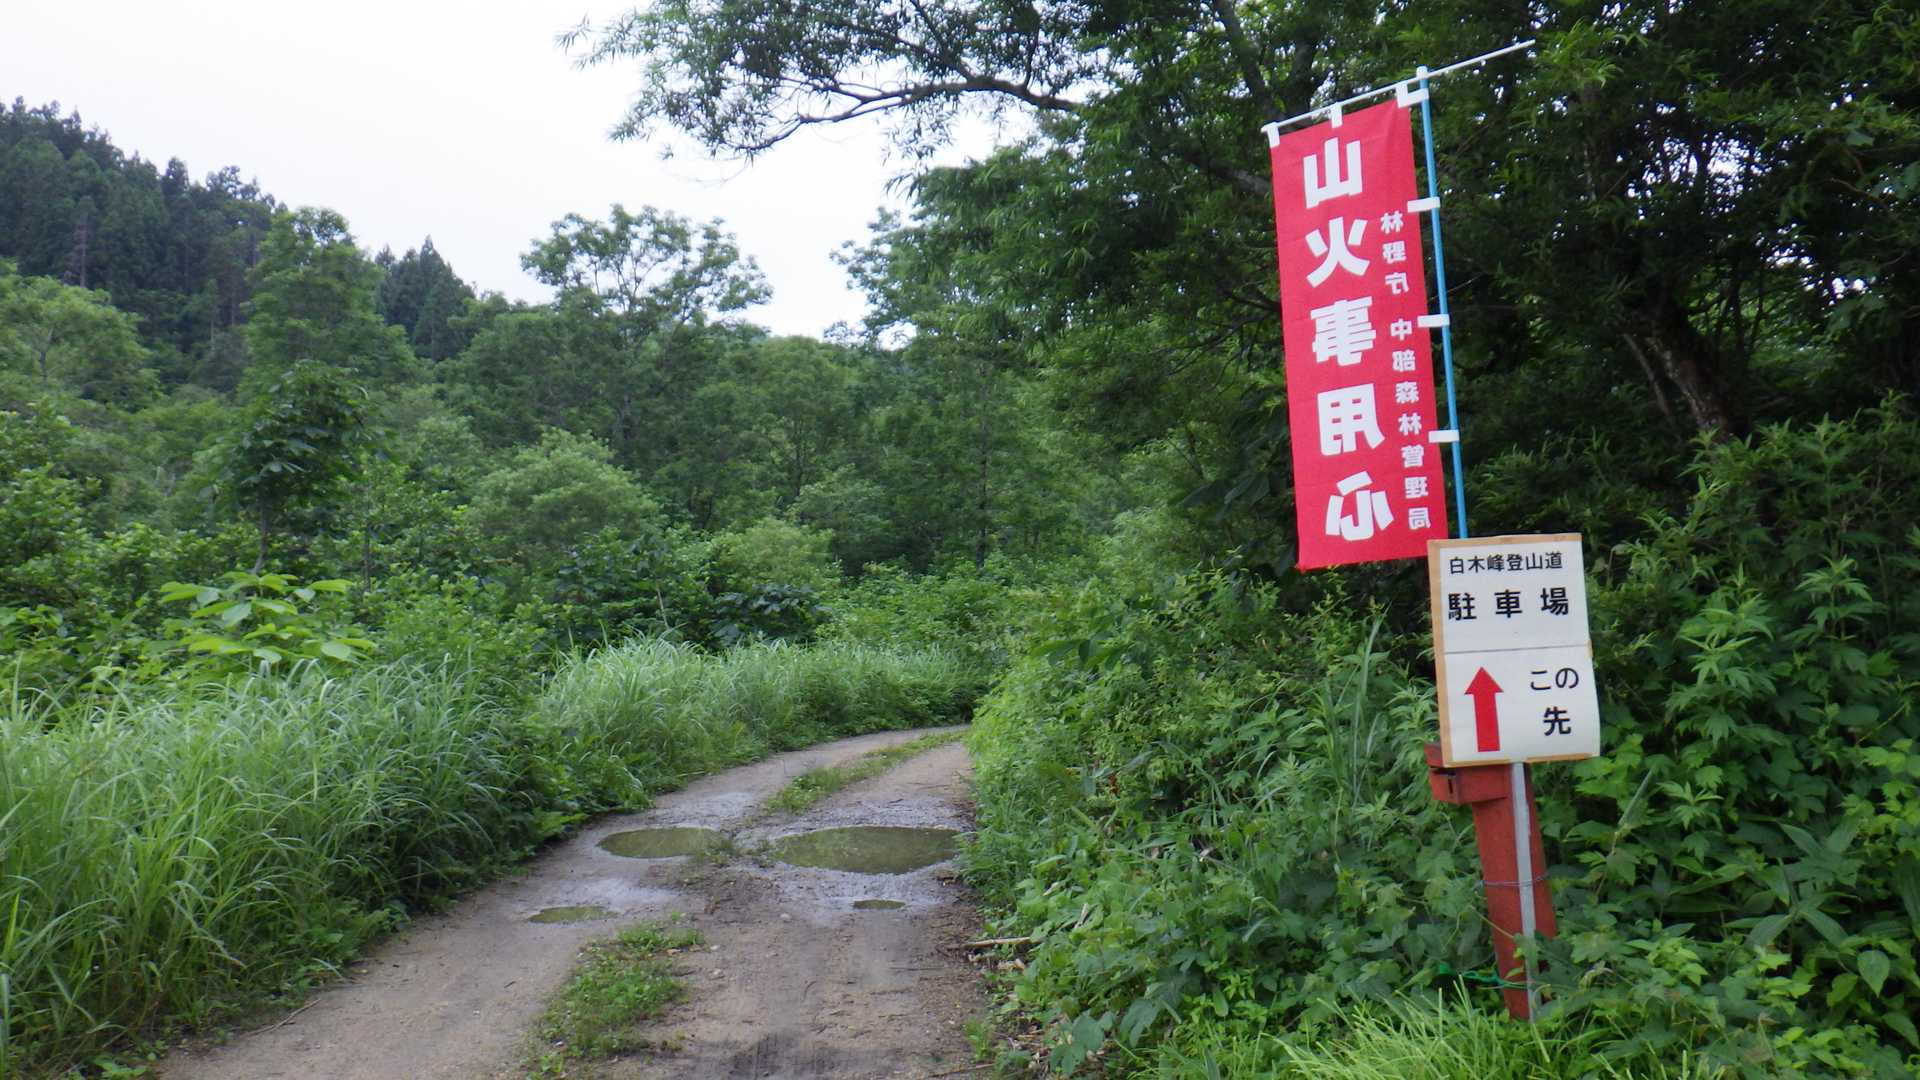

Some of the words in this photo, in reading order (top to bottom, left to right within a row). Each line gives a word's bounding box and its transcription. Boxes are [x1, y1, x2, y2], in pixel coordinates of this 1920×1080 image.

[1450, 551, 1562, 574] 白木峰登山道
[1448, 586, 1569, 621] 駐車場
[1530, 667, 1579, 691] この
[1543, 706, 1572, 736] 先
